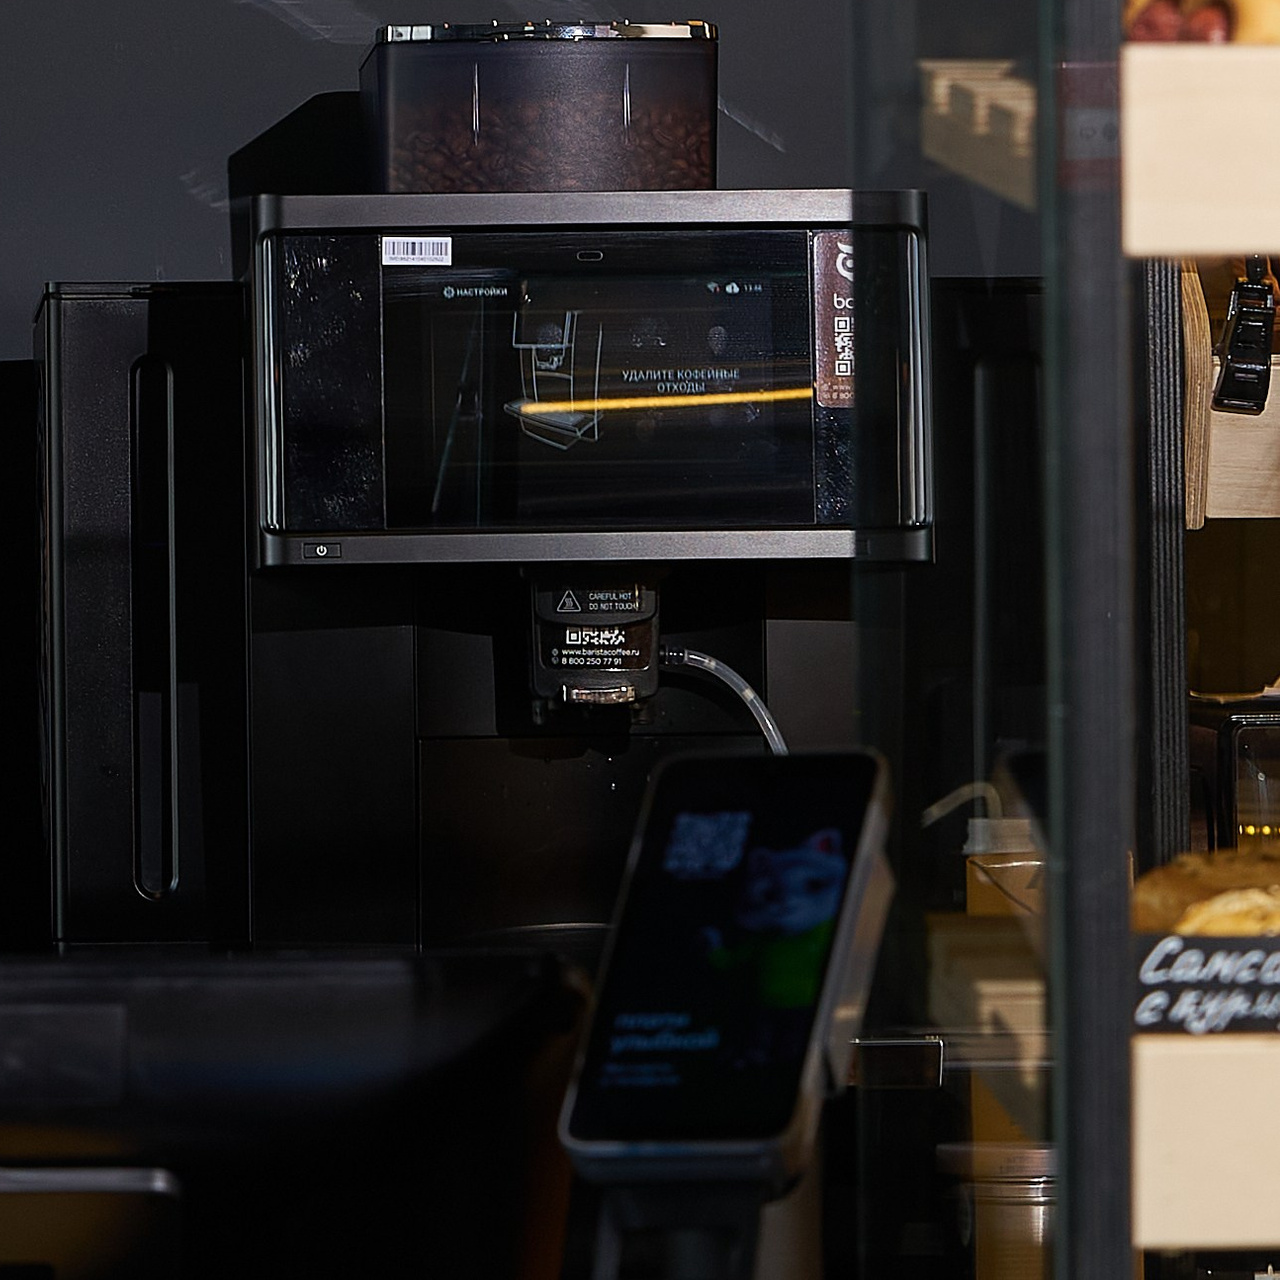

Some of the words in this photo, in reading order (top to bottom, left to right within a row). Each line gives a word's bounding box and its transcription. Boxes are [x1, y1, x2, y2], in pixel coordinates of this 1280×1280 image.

[456, 285, 508, 298] НАСТРОЙКИ
[621, 369, 675, 382] УДАЛИТЕ
[656, 381, 706, 394] ОТХОДЫ
[588, 593, 618, 601] CAREFUL
[588, 602, 598, 611] DO
[599, 602, 613, 611] NOT
[561, 647, 640, 657] www.baristacoffee.ru
[569, 657, 585, 665] 800
[586, 657, 602, 665] 250
[603, 657, 612, 665] 77
[613, 657, 622, 665] 91
